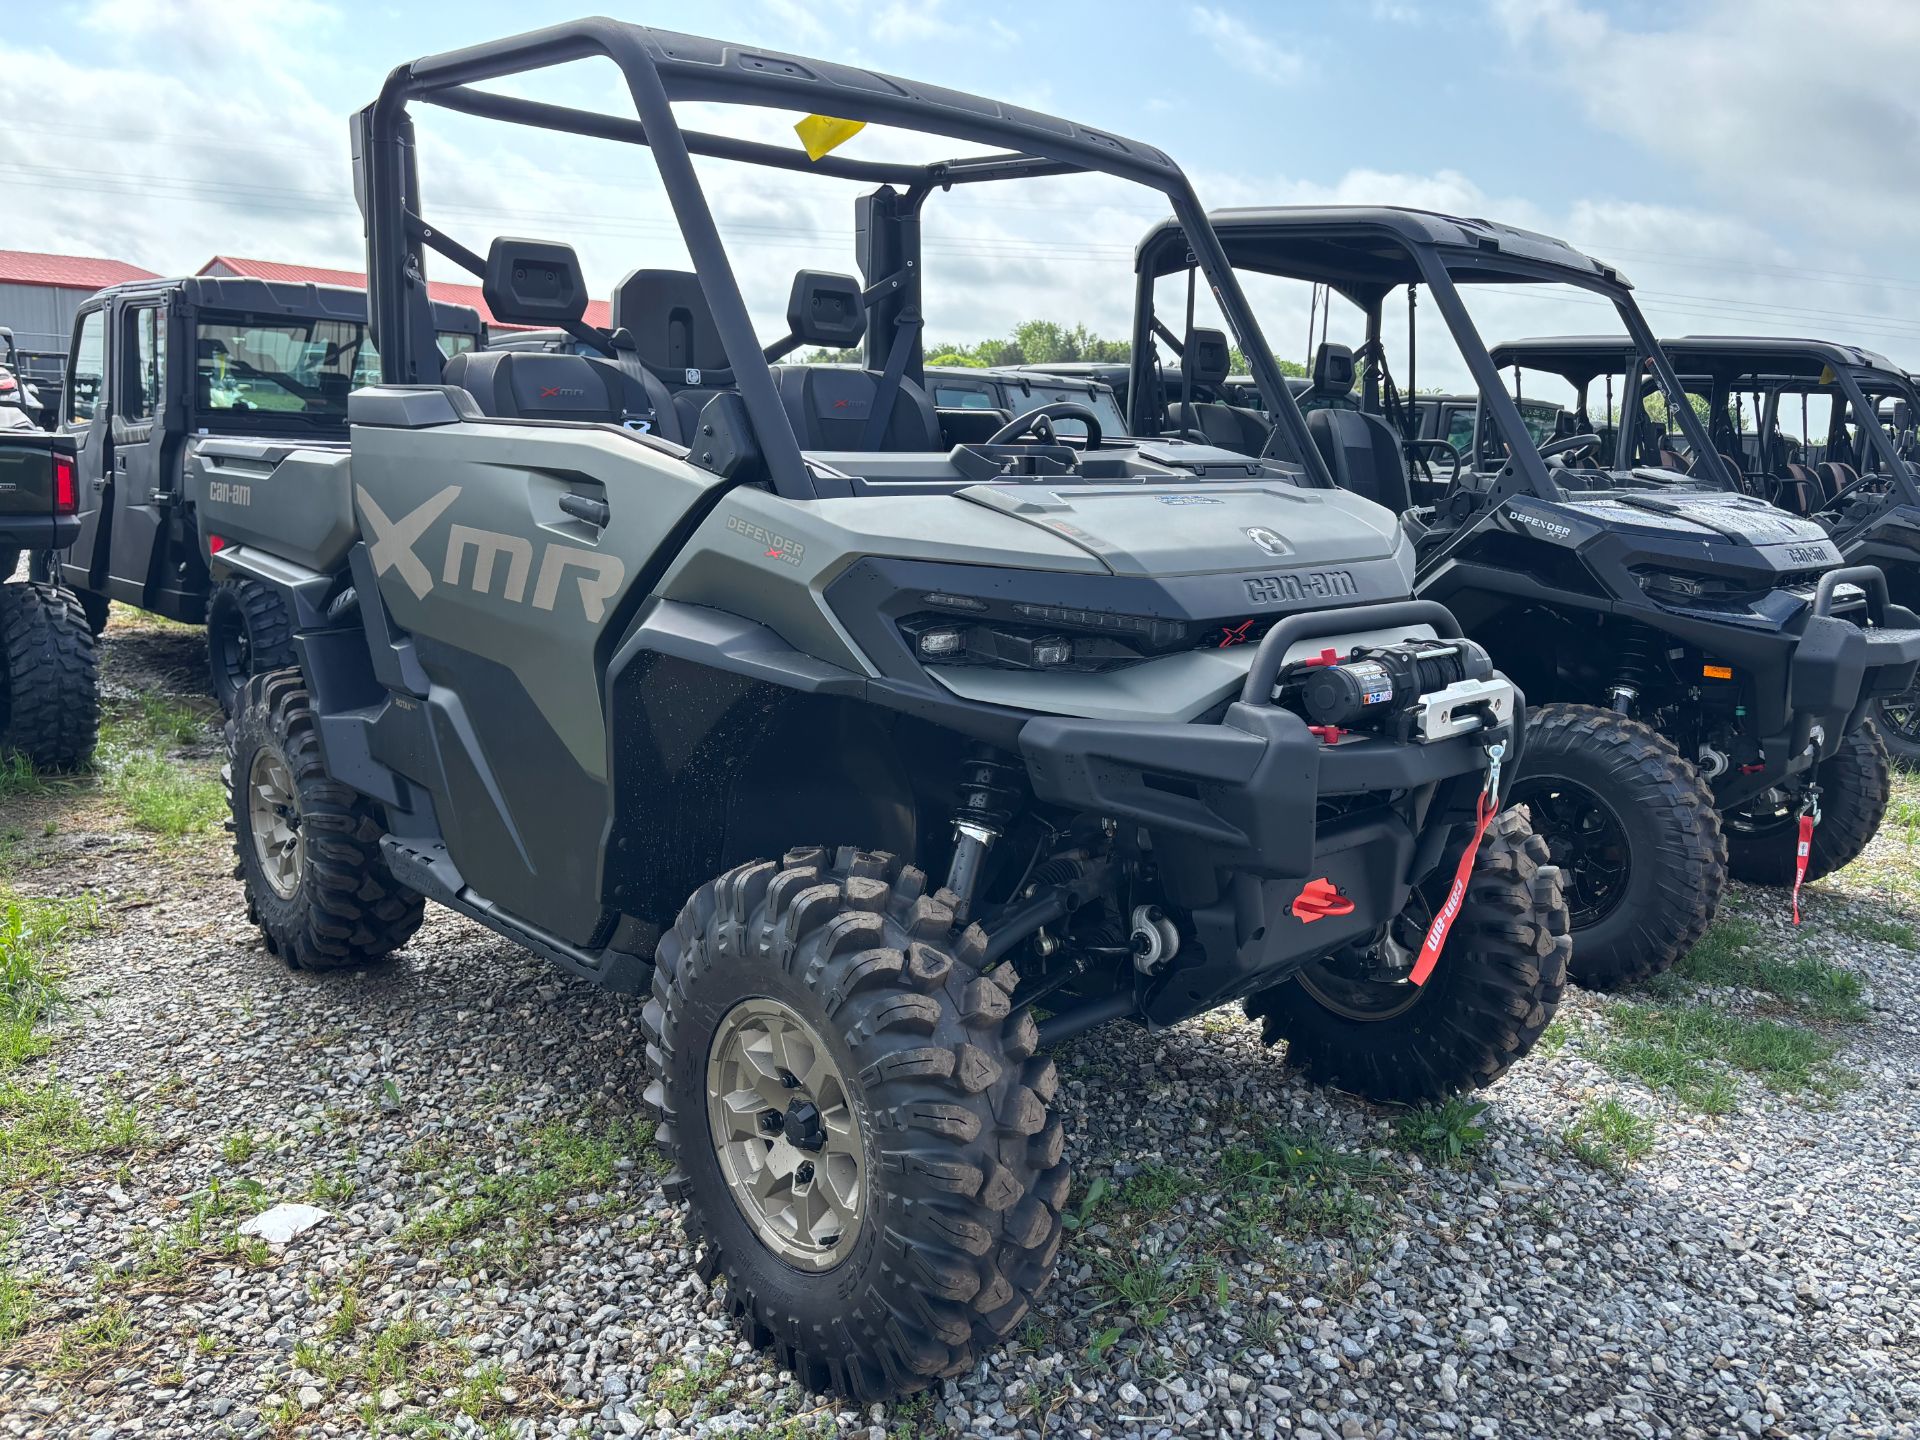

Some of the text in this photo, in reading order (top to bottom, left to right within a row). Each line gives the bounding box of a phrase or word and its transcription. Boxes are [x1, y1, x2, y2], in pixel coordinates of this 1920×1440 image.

[210, 481, 251, 506] can-am
[727, 516, 804, 556] DEFENDER
[1509, 511, 1571, 536] DEFENDER
[1545, 530, 1568, 539] XT
[1785, 546, 1829, 563] can-am
[1243, 571, 1358, 605] can-am
[1427, 878, 1463, 952] can-am
